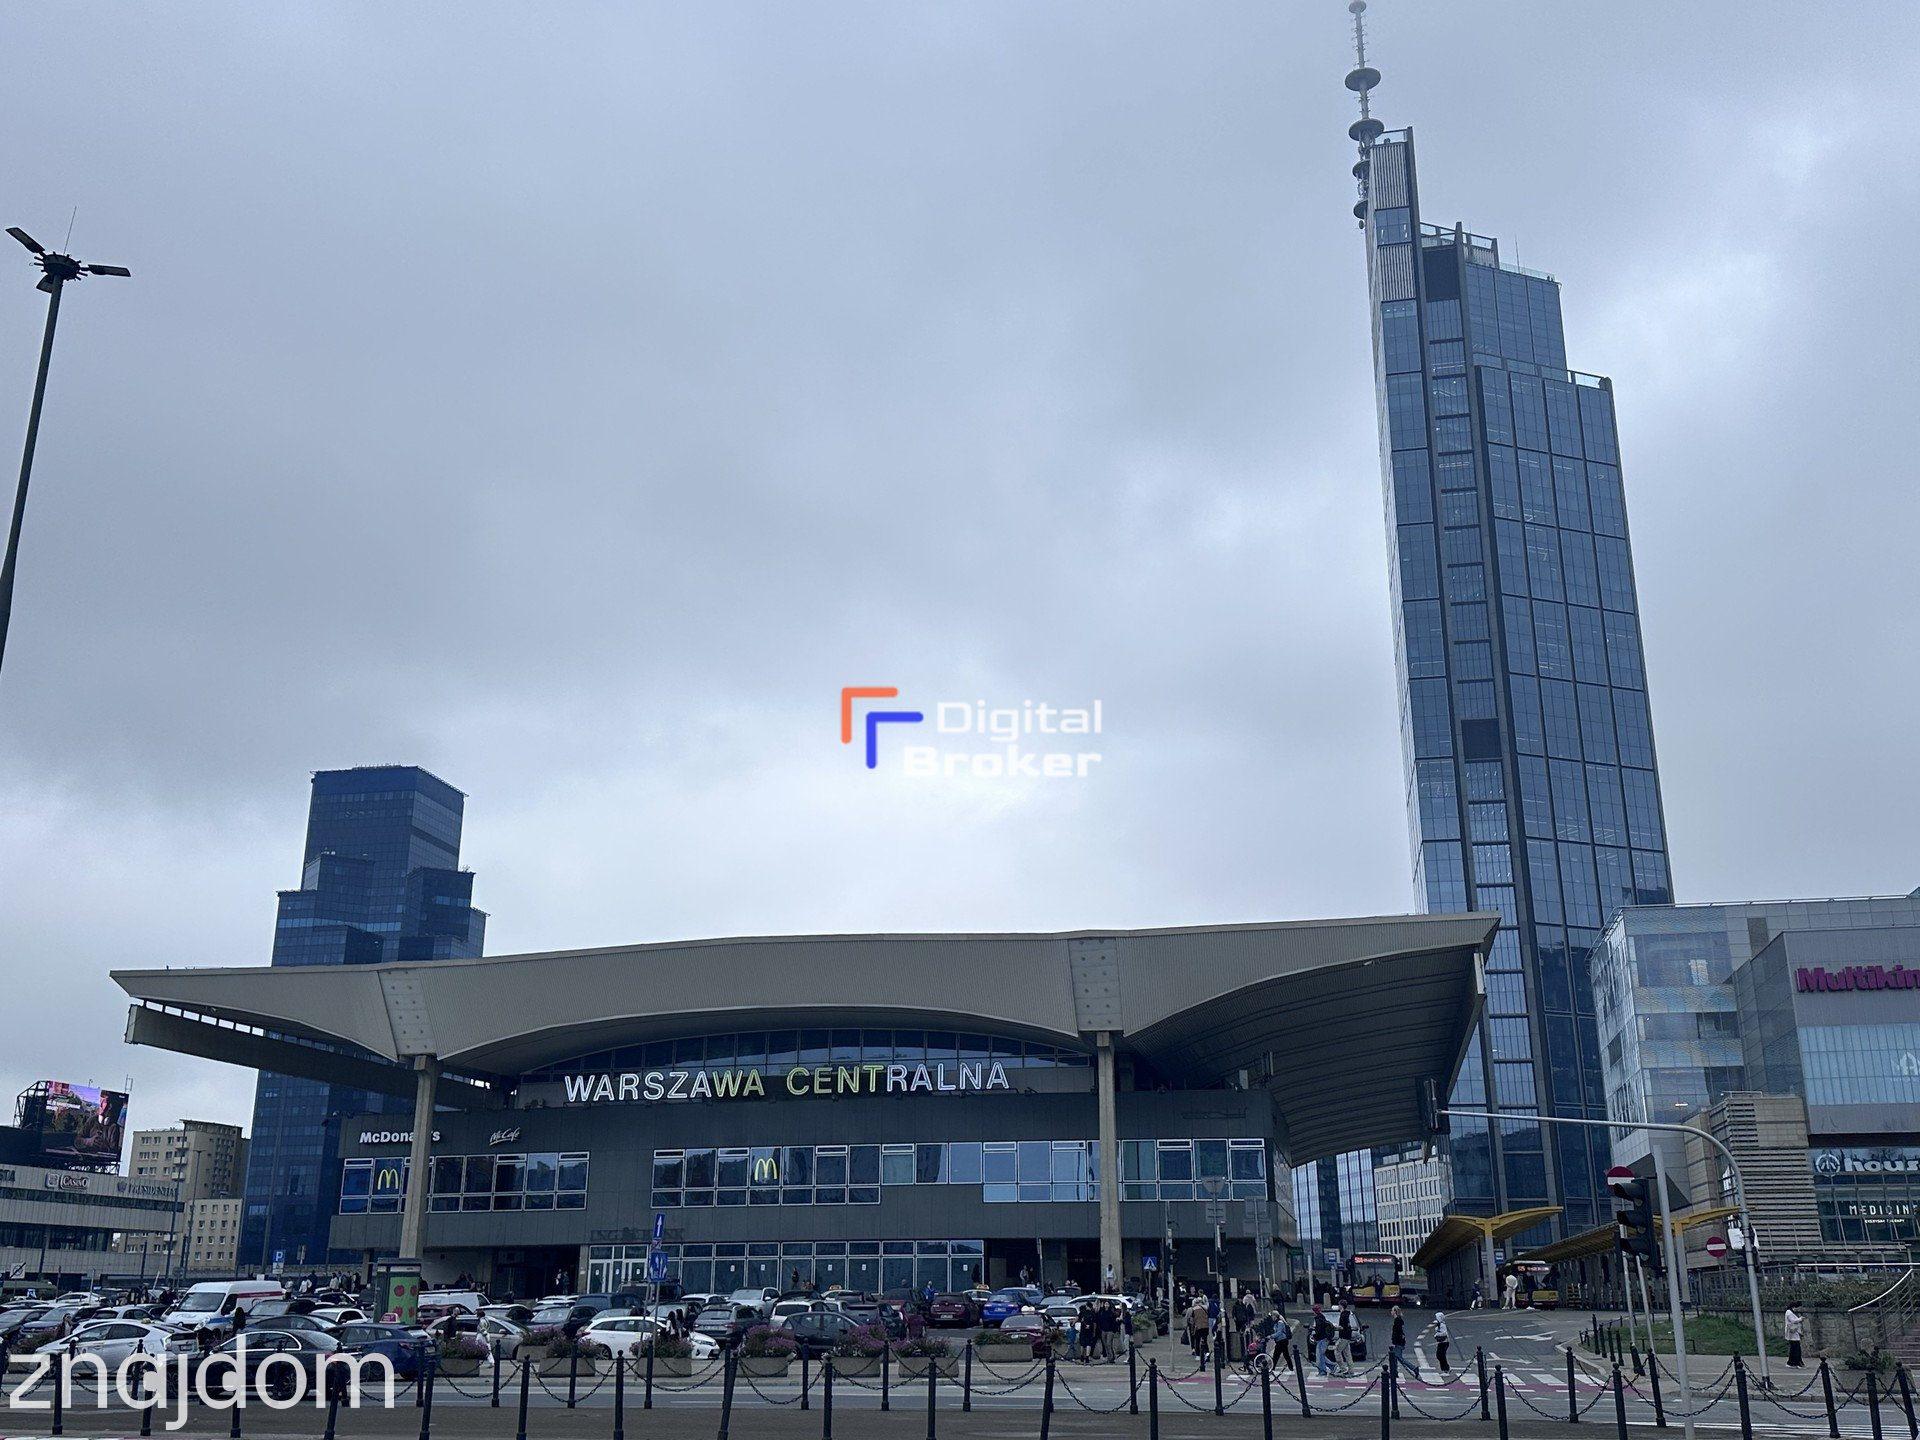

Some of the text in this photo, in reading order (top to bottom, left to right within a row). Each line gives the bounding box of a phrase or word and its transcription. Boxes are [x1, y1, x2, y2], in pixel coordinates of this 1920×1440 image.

[564, 1061, 1010, 1102] WARSZAWA CENTRALNA
[359, 1131, 441, 1144] McDona's
[1844, 1157, 1920, 1172] hous
[275, 1251, 284, 1262] P
